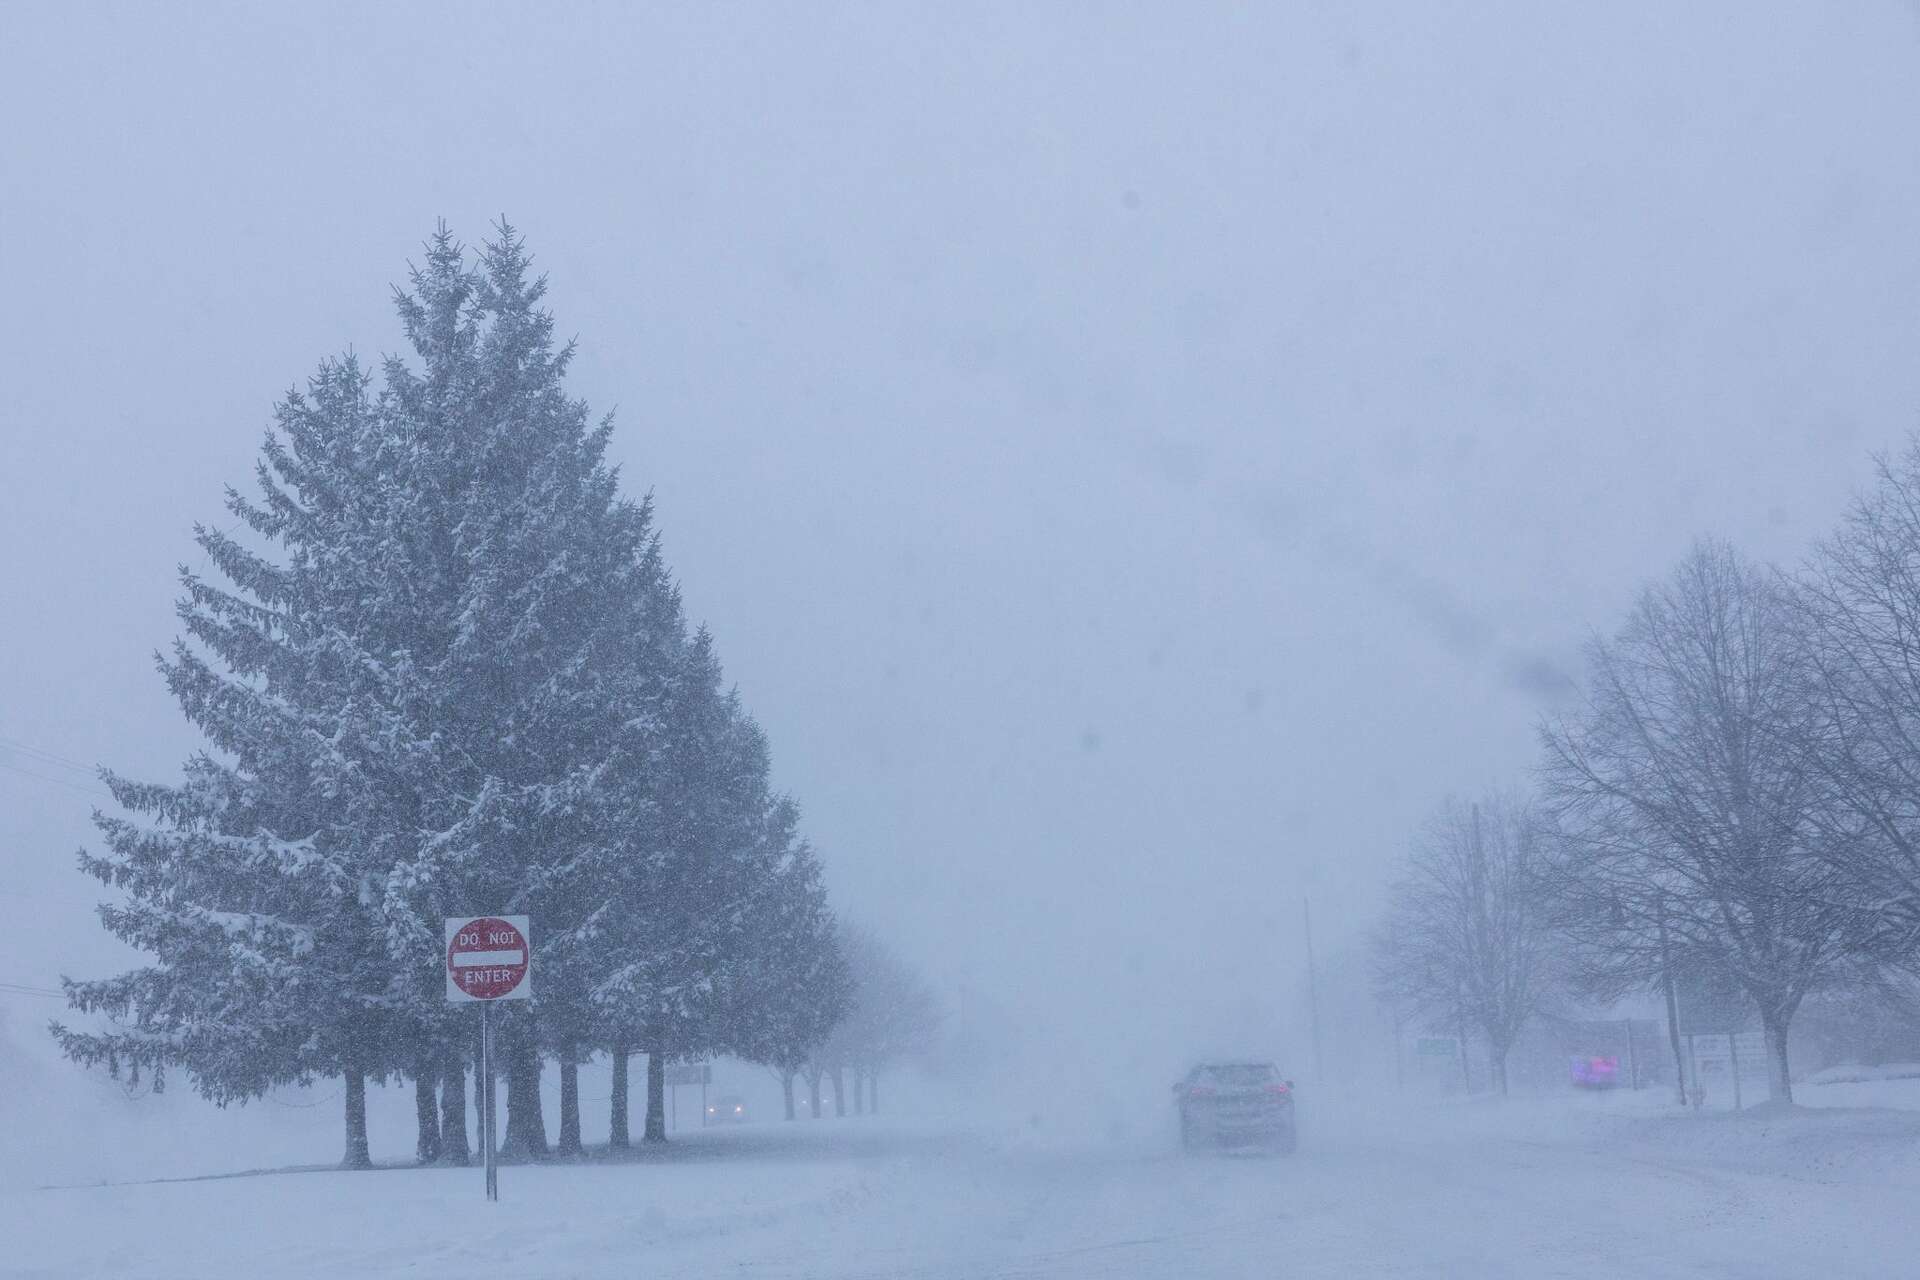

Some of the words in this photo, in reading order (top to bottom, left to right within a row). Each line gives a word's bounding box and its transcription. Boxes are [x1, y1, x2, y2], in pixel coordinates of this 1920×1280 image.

[460, 933, 479, 945] DO
[489, 931, 515, 945] NOT
[465, 969, 511, 983] ENTER
